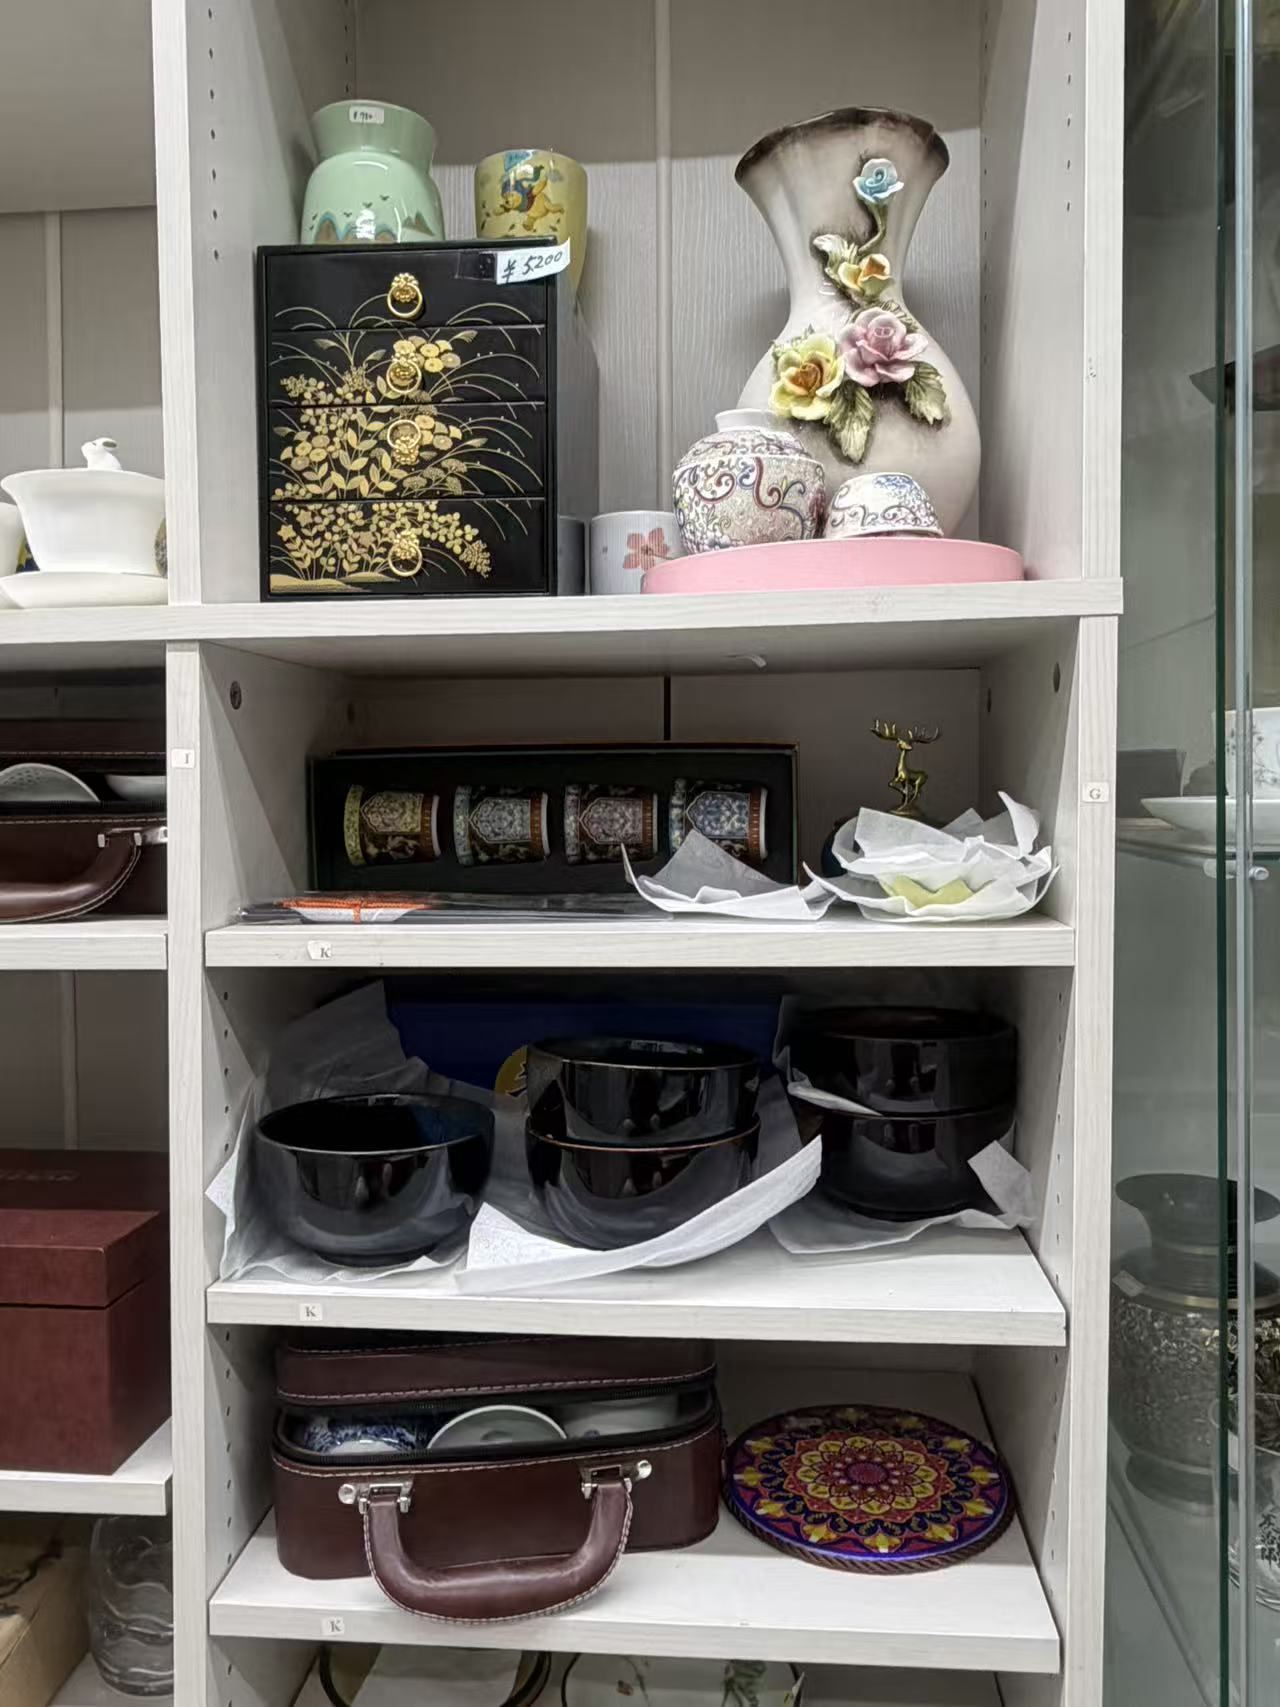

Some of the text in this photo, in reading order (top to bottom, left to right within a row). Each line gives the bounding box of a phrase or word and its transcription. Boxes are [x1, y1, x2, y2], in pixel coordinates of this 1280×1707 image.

[1089, 787, 1101, 800] G
[320, 947, 331, 959] K
[305, 1305, 316, 1317] K
[330, 1620, 342, 1632] K
